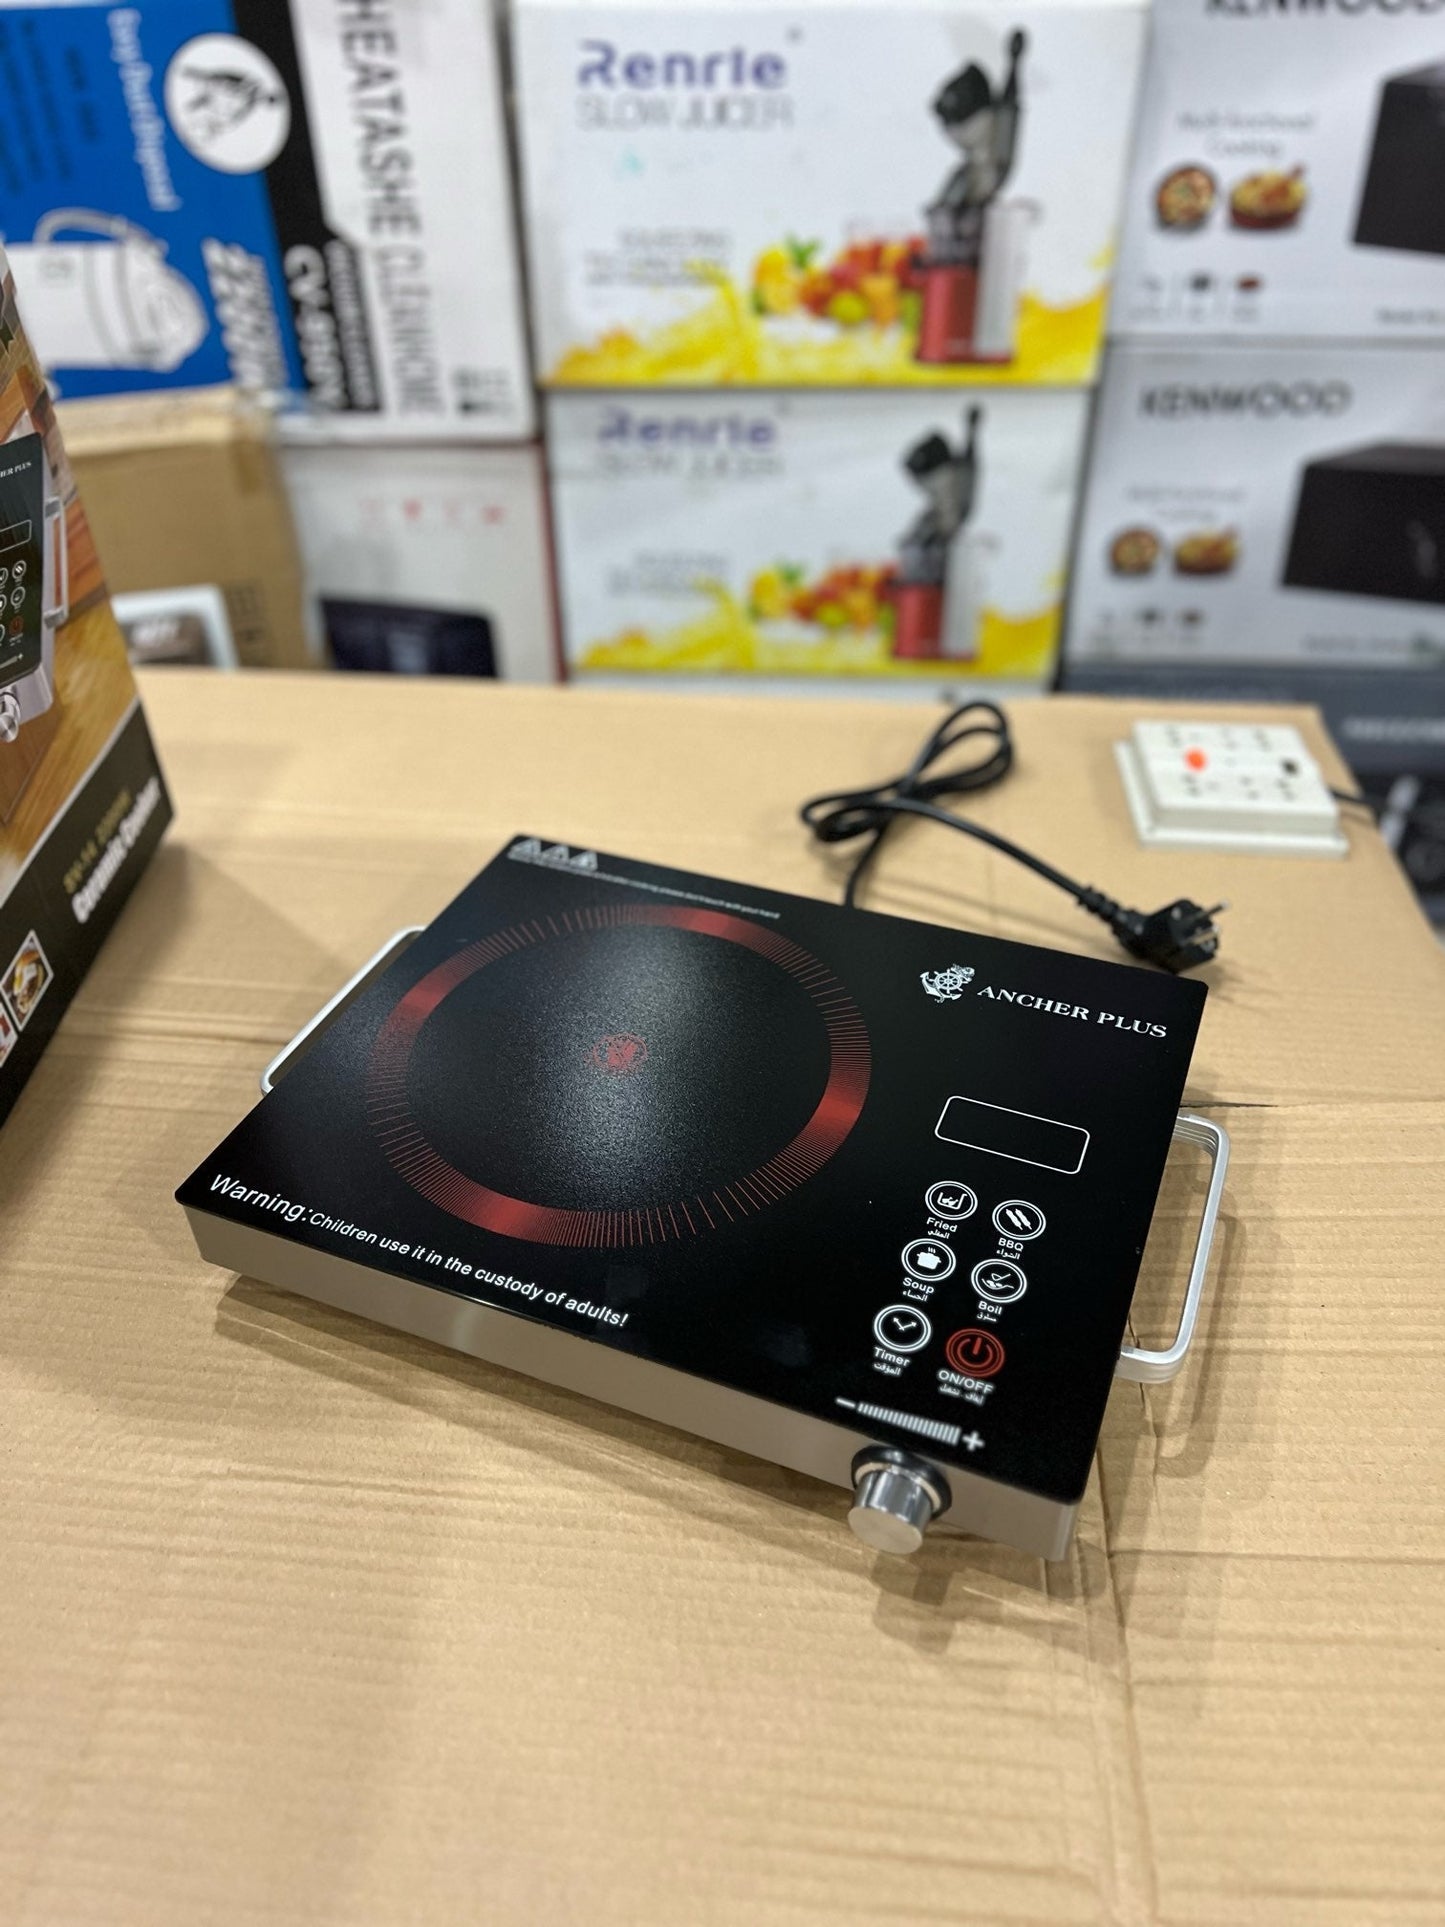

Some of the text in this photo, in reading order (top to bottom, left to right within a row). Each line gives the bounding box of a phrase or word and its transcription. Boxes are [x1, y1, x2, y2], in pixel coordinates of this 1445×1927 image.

[977, 985, 1168, 1038] ANCHER PLUS
[926, 1216, 958, 1233] Fried
[998, 1238, 1024, 1251] BBQ
[379, 1235, 410, 1255] use
[411, 1244, 426, 1261] it
[425, 1249, 440, 1265] in
[444, 1254, 472, 1276] the
[474, 1267, 544, 1300] custody
[545, 1289, 568, 1306] of
[566, 1295, 630, 1327] adults!
[903, 1276, 935, 1296] Soup
[978, 1300, 1002, 1316] Boil
[873, 1346, 911, 1368] Timer
[937, 1370, 995, 1396] ON/OFF
